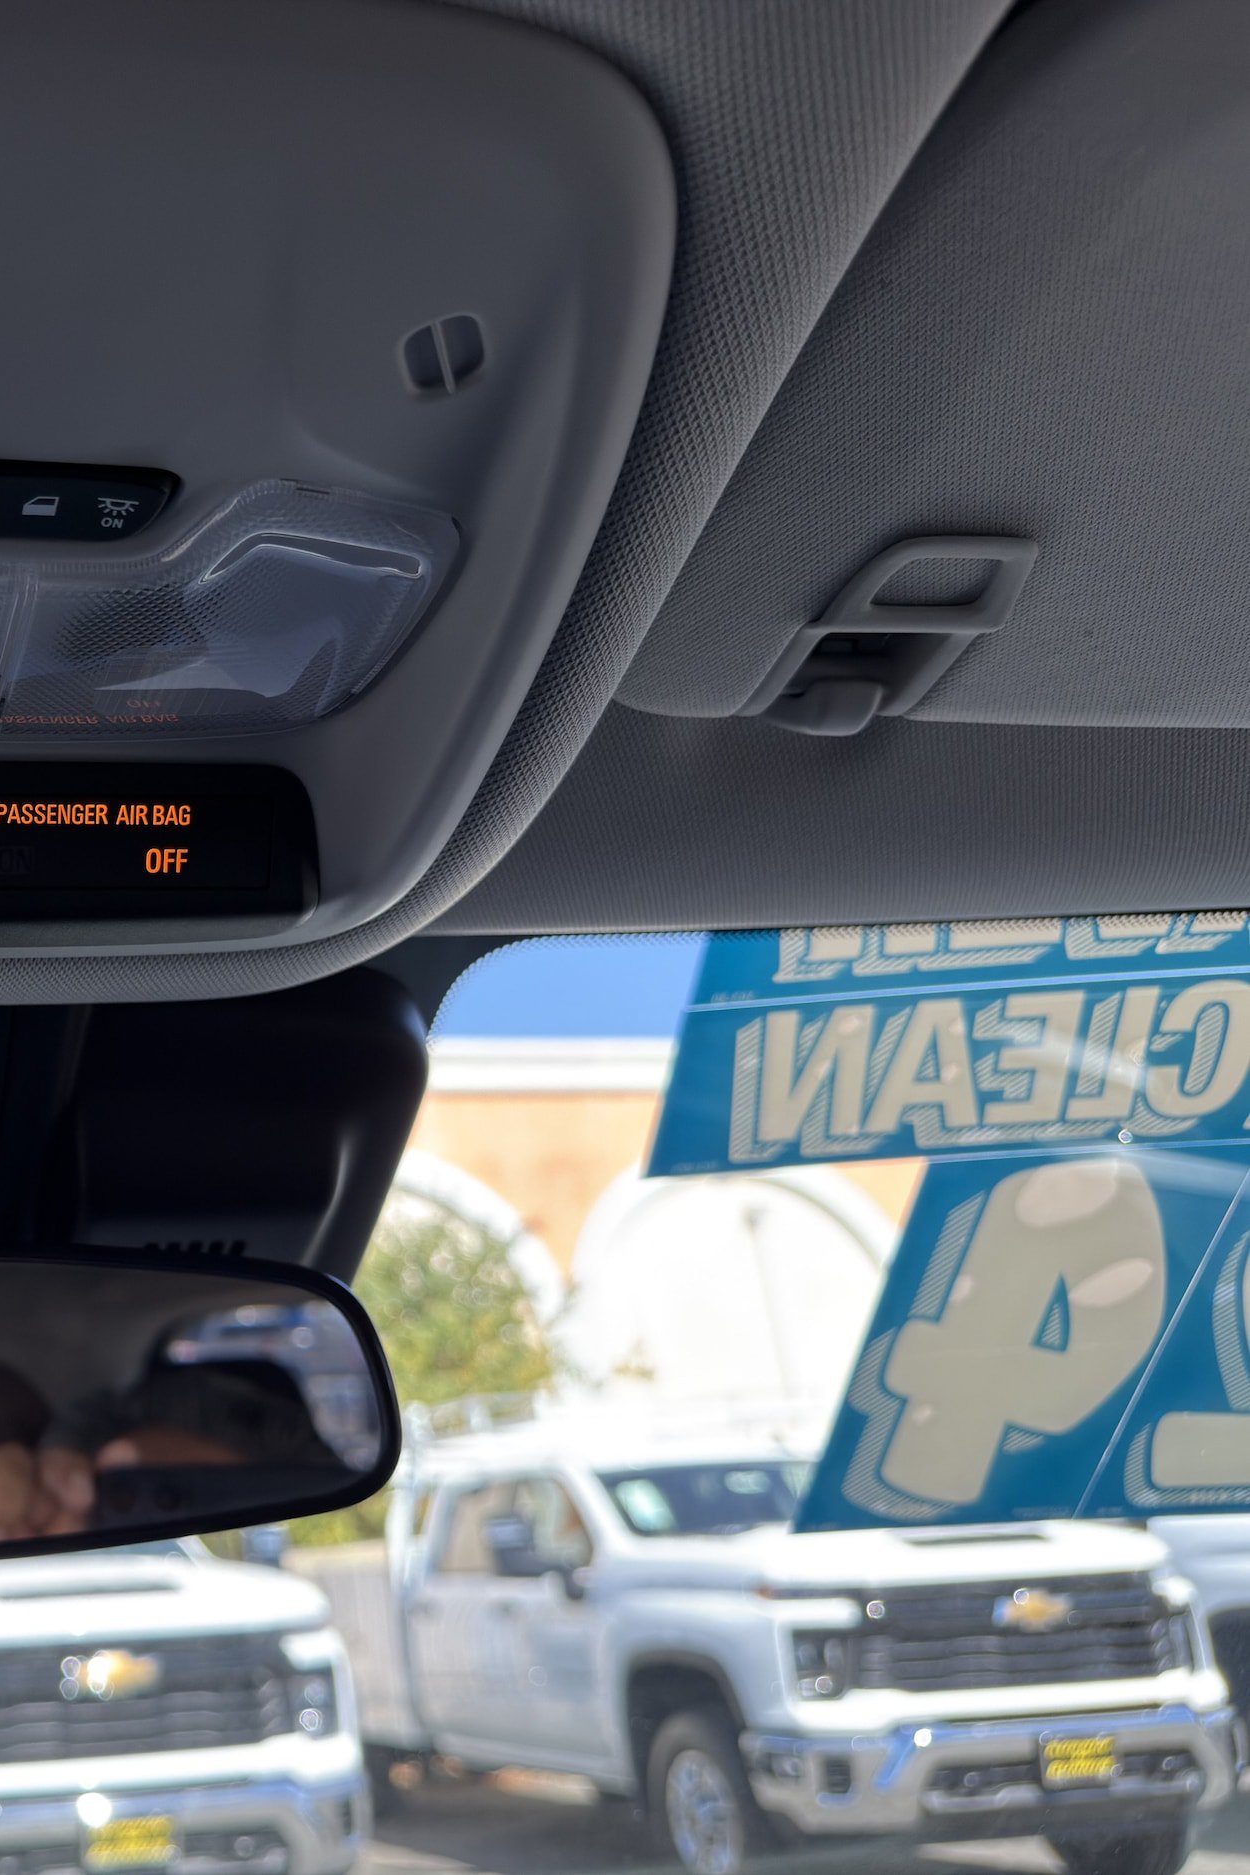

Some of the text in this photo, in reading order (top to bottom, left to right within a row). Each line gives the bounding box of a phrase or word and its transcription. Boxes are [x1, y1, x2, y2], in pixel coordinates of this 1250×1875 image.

[100, 516, 124, 529] ON
[115, 804, 149, 827] AIR
[152, 804, 192, 827] BAG
[144, 847, 190, 875] OFF
